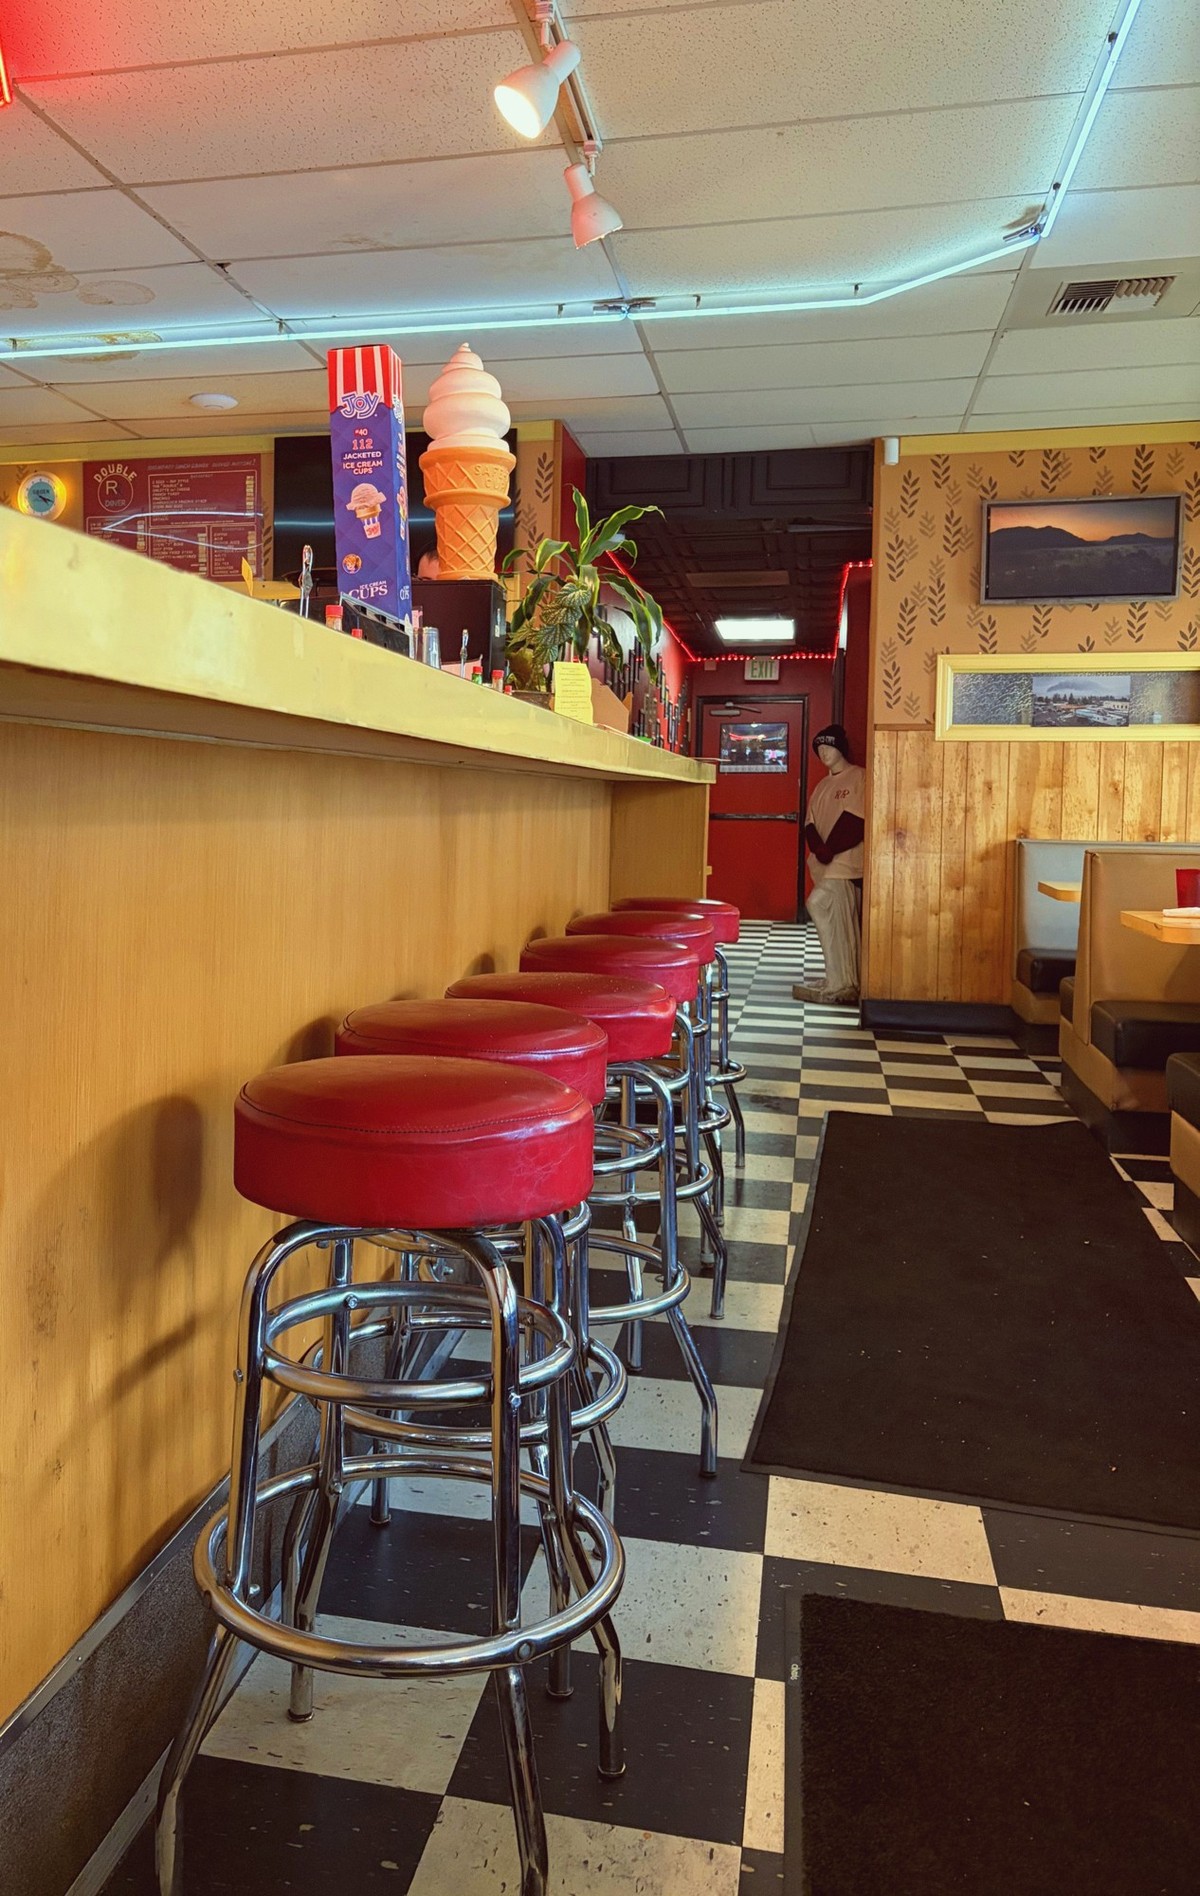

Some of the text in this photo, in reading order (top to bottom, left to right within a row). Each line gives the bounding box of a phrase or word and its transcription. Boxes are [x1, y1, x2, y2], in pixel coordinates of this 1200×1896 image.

[340, 391, 380, 419] JOY
[352, 438, 374, 450] 112
[343, 451, 382, 460] JACKETED
[357, 460, 383, 468] CREAM
[94, 464, 138, 482] DOUBLE
[353, 467, 373, 475] CUPS
[106, 480, 118, 495] R
[369, 580, 387, 588] CREAM
[348, 585, 388, 600] CUPS
[750, 660, 775, 679] EXIT
